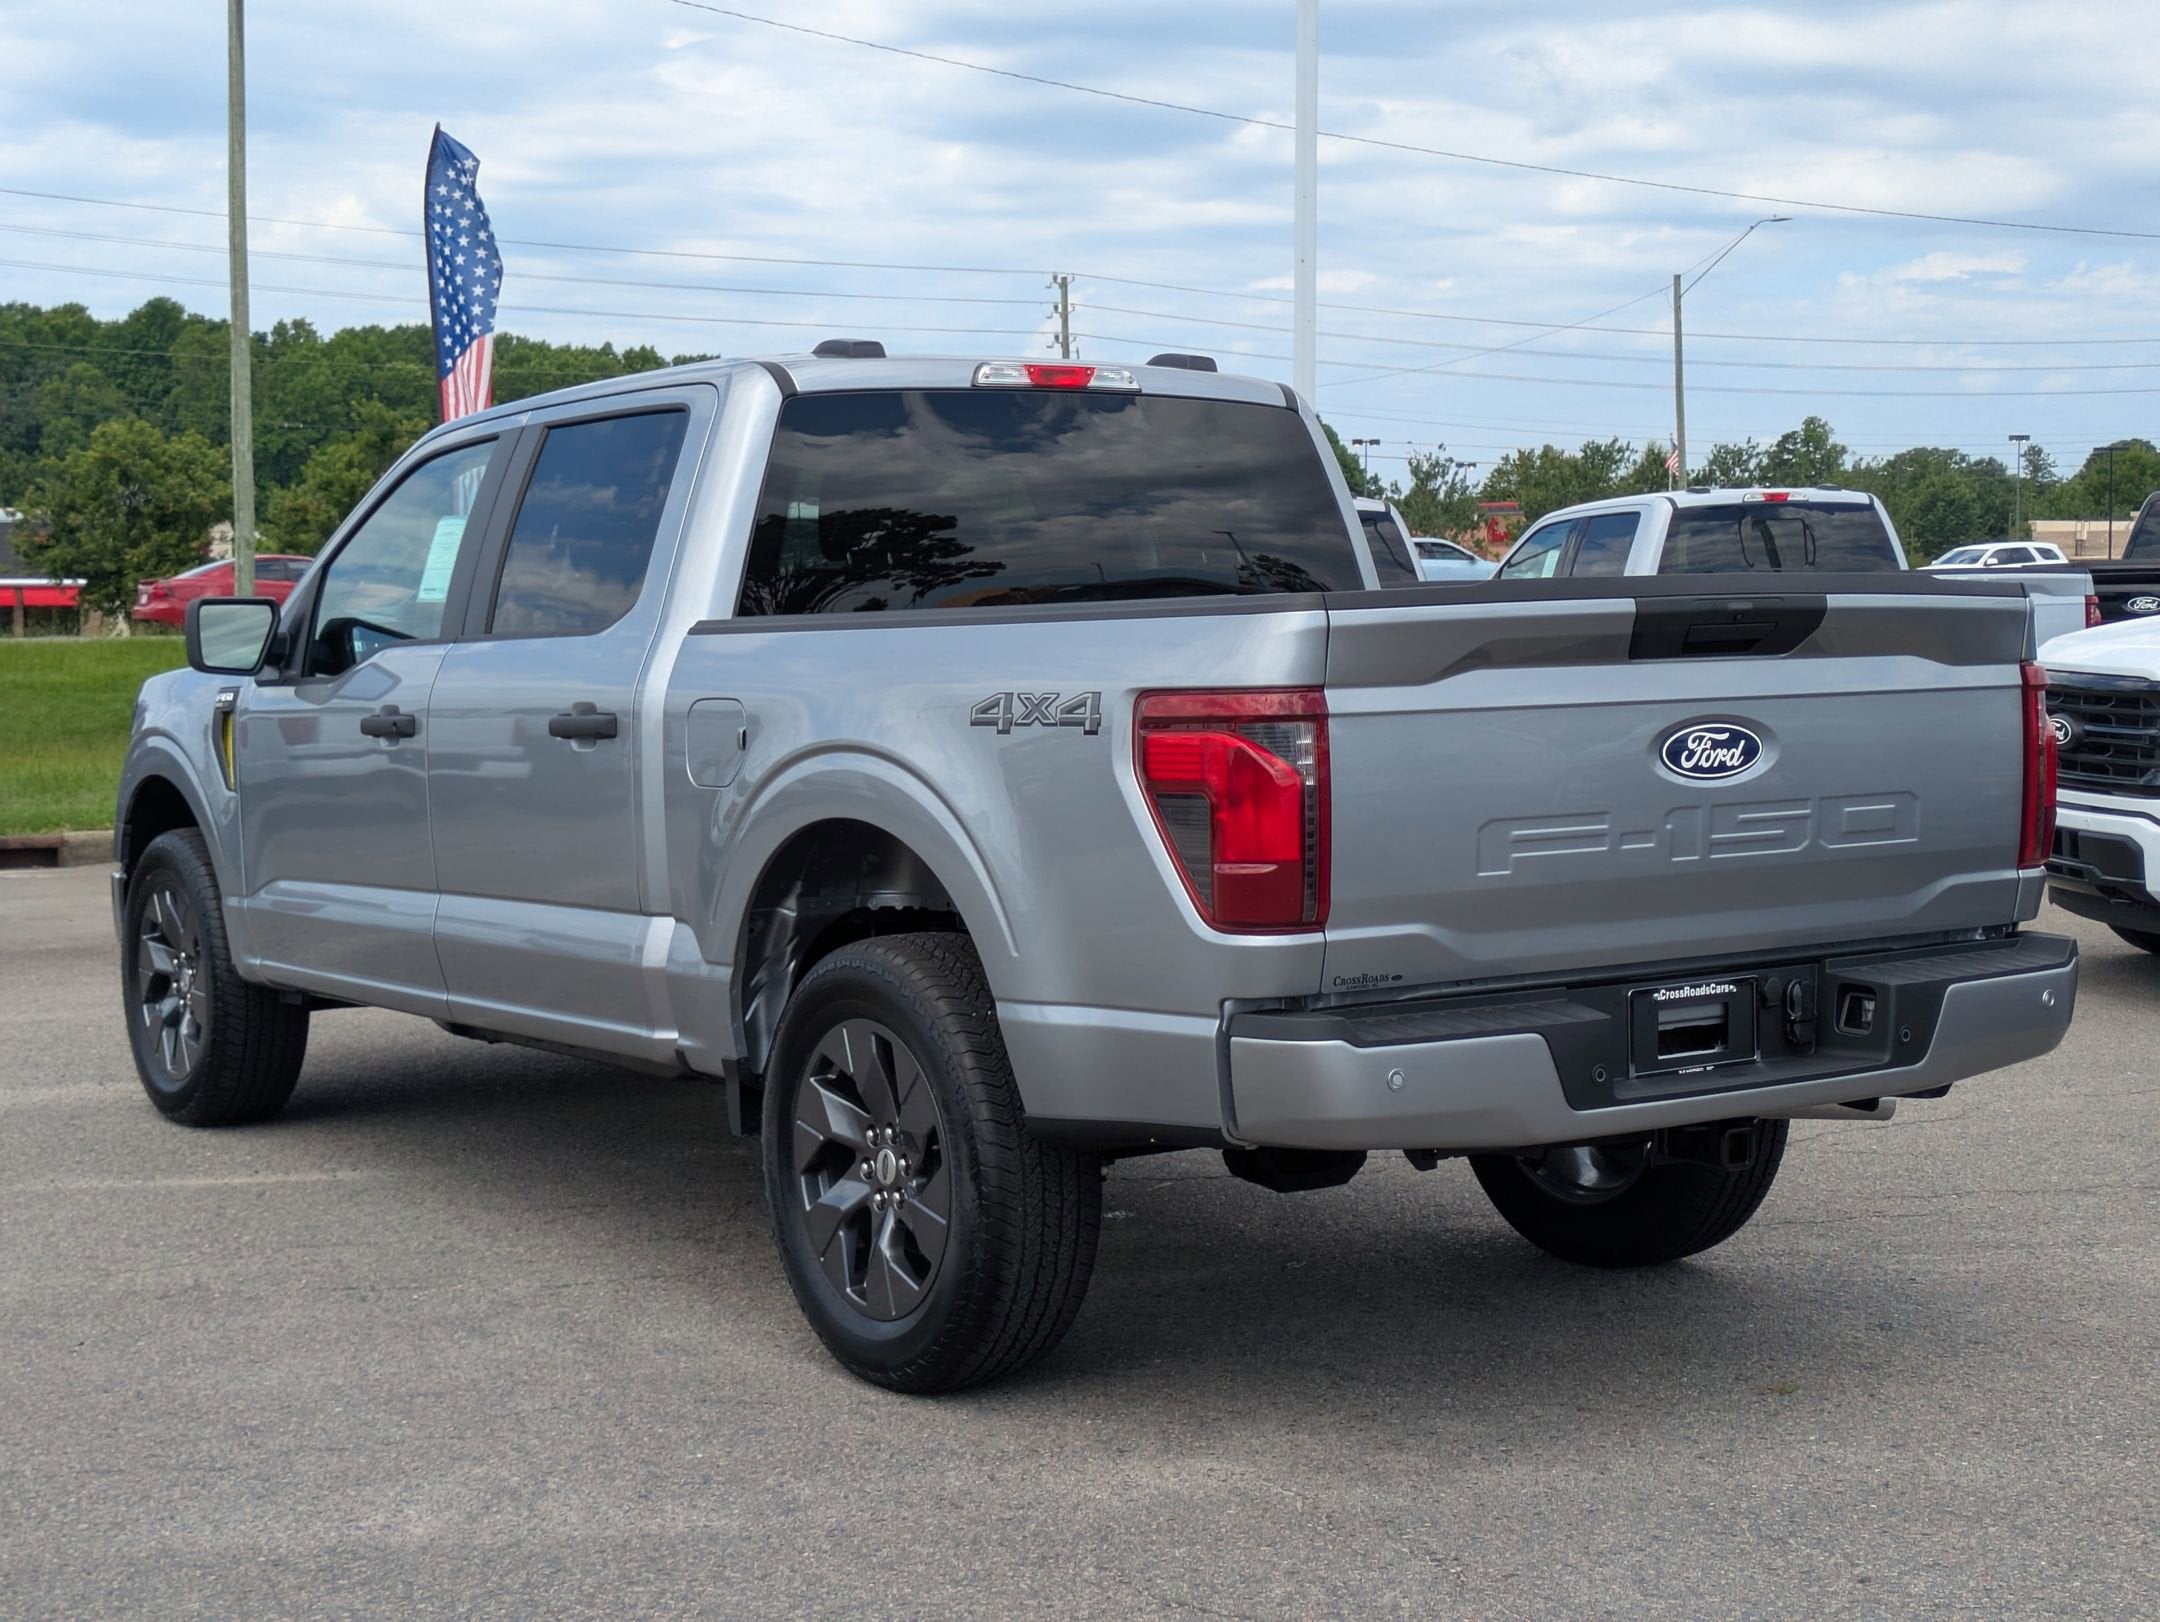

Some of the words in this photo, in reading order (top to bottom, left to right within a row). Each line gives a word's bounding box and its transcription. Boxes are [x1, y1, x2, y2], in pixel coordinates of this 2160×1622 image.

[2133, 599, 2158, 609] Ford
[1681, 731, 1745, 769] Ford
[1477, 791, 1918, 876] F-150
[1659, 983, 1729, 1000] CrossRoadsCars
